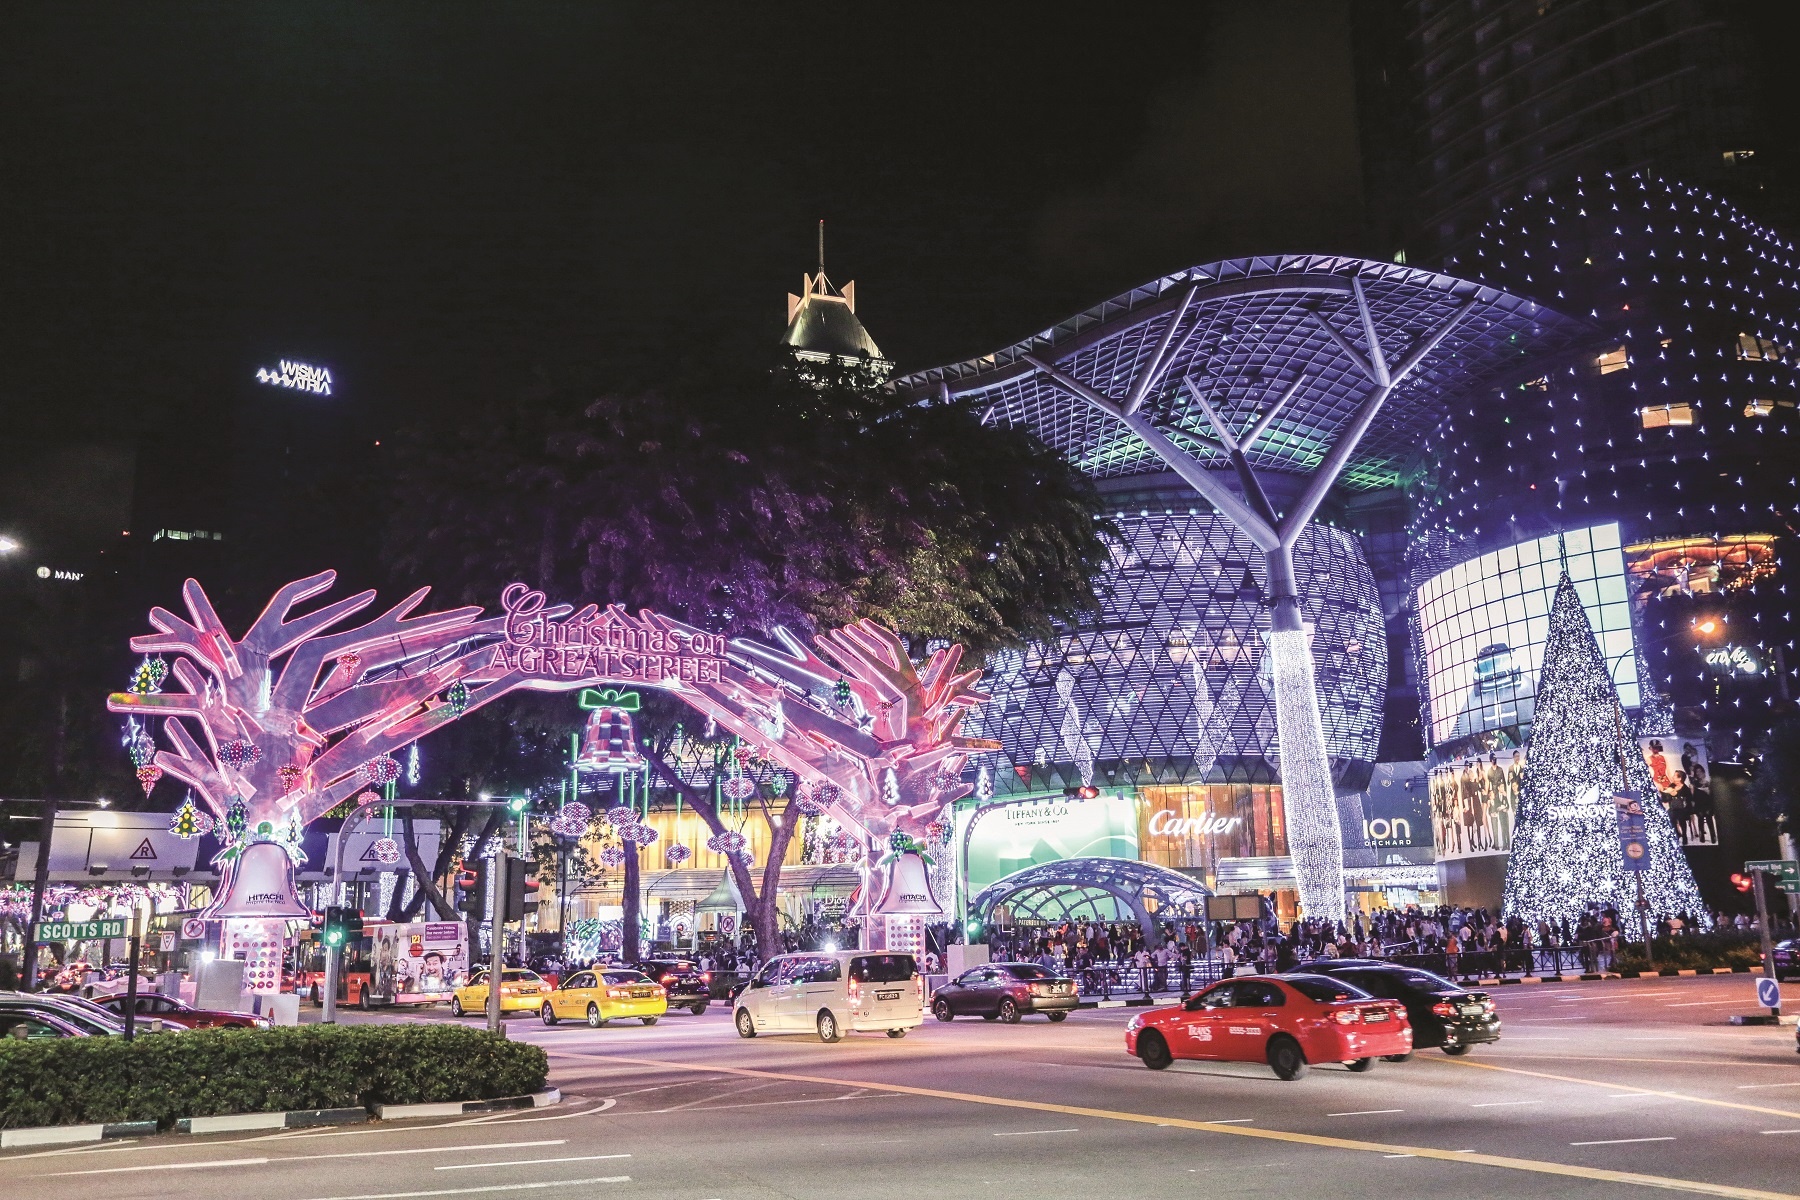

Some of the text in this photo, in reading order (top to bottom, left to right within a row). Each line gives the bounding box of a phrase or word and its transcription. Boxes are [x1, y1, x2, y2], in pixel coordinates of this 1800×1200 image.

[280, 358, 332, 383] WISMA
[290, 375, 332, 395] ATRIA
[54, 570, 84, 581] MAN
[501, 582, 729, 659] Christmas on
[1005, 808, 1043, 820] TIFFANY
[1546, 804, 1617, 820] SWAROVS
[1148, 809, 1242, 837] Cartier
[1364, 839, 1412, 847] ORCHARD
[140, 846, 149, 856] R
[248, 893, 284, 901] HITACHI
[825, 894, 846, 905] Dior
[42, 922, 121, 939] SCOTTS RD
